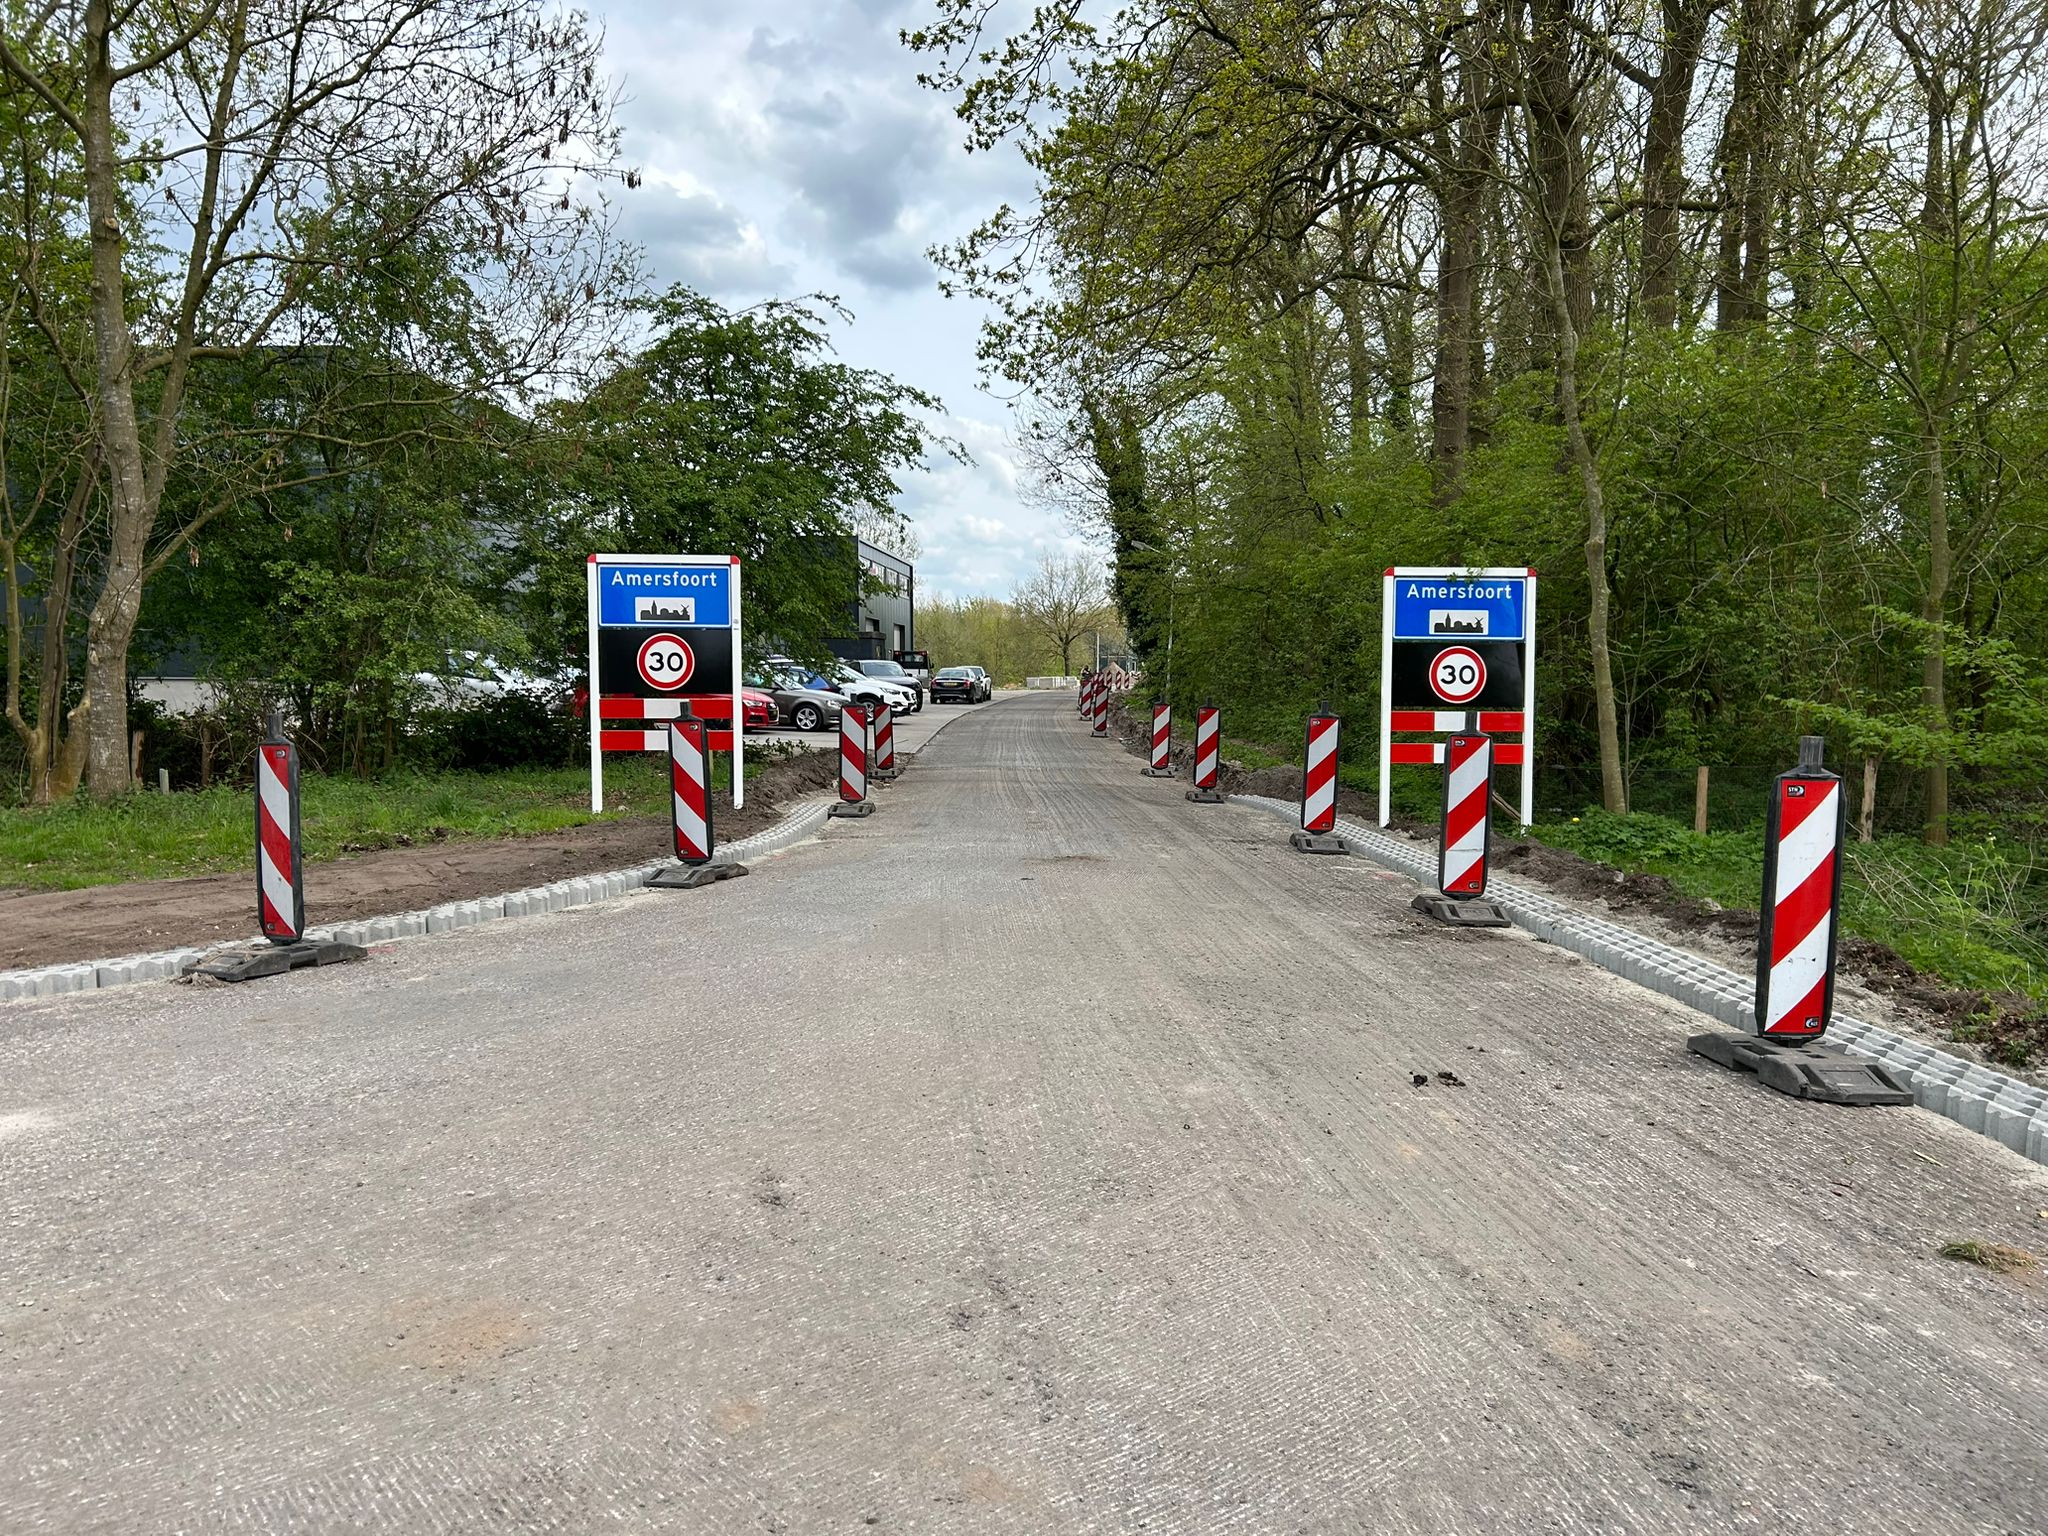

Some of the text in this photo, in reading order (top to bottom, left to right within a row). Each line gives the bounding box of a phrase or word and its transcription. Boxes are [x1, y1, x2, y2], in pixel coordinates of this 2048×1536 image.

[611, 570, 717, 587] Amersfoort
[1406, 583, 1512, 599] Amersfoort
[648, 651, 684, 672] 30
[1440, 664, 1476, 685] 30
